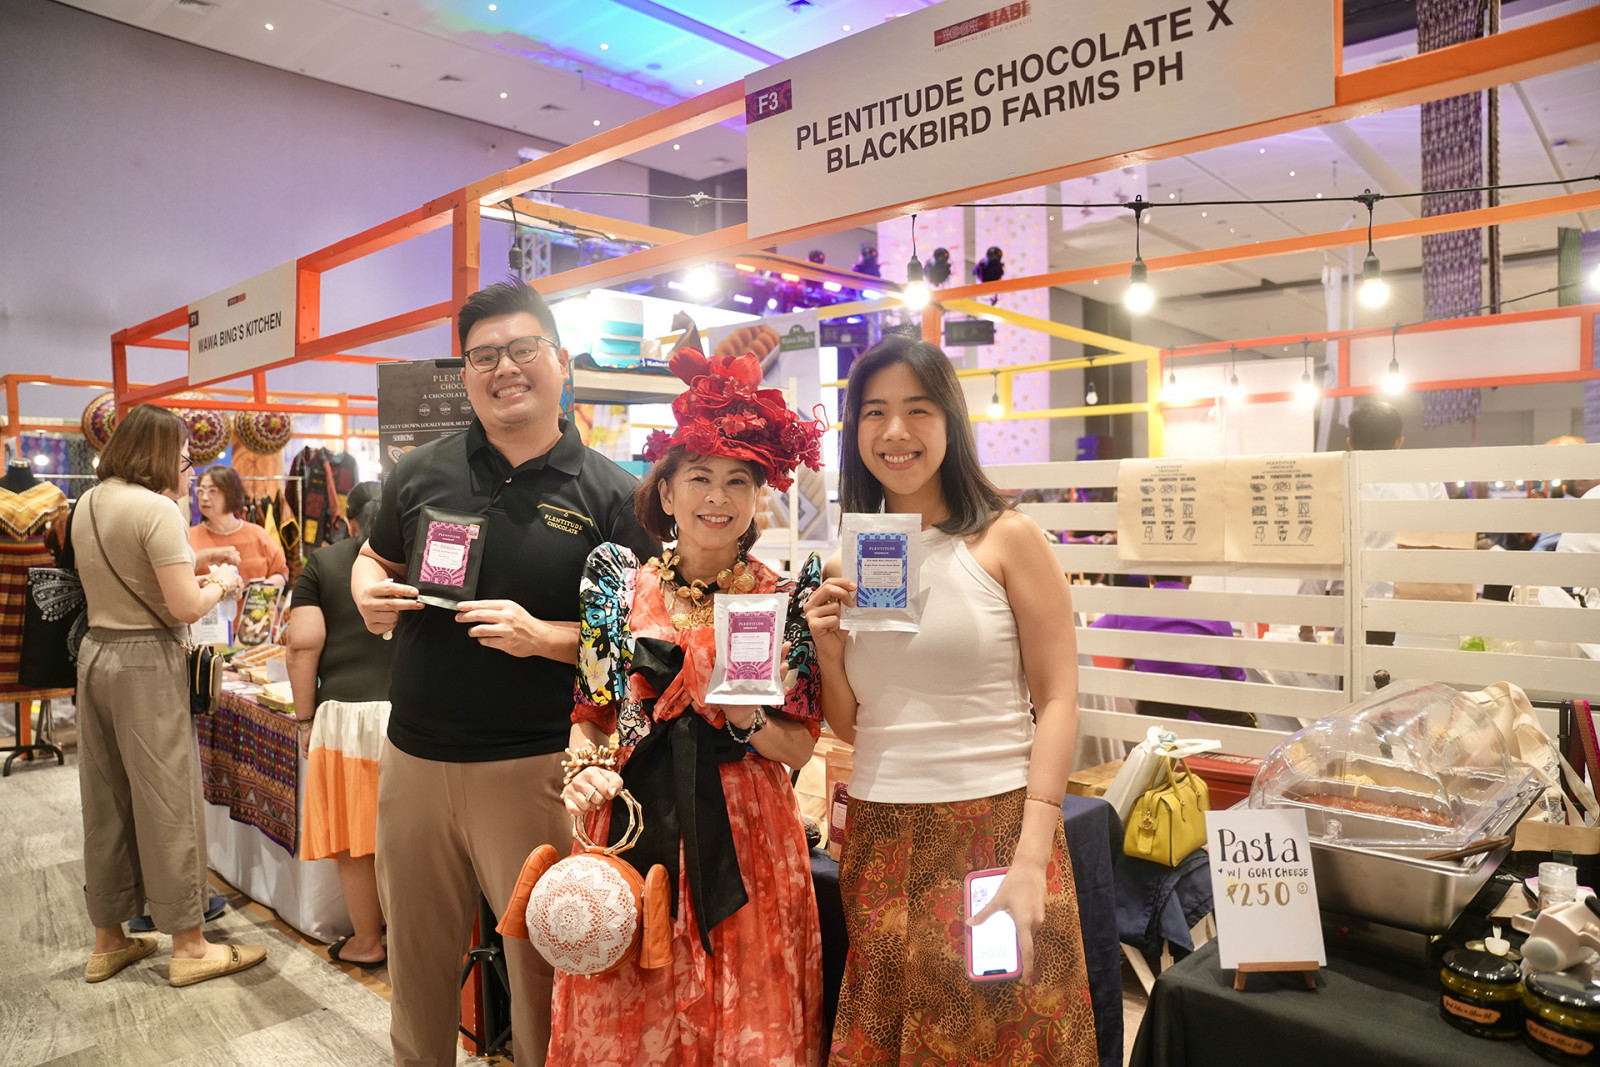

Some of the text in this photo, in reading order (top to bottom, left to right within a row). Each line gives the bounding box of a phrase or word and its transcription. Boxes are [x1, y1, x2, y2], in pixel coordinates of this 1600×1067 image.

[797, 0, 1234, 150] PLENTITUDE CHOCOLATE X
[758, 92, 779, 114] F3
[827, 51, 1183, 174] BLACKBIRD FARMS PH
[198, 311, 282, 354] WAWA BING'S KITCHEN
[544, 514, 583, 530] PLENTITUDE
[547, 521, 578, 535] CHOCOLATE
[1217, 828, 1300, 863] Pasta
[1248, 868, 1272, 878] GOAT
[1274, 868, 1309, 878] CHEESE
